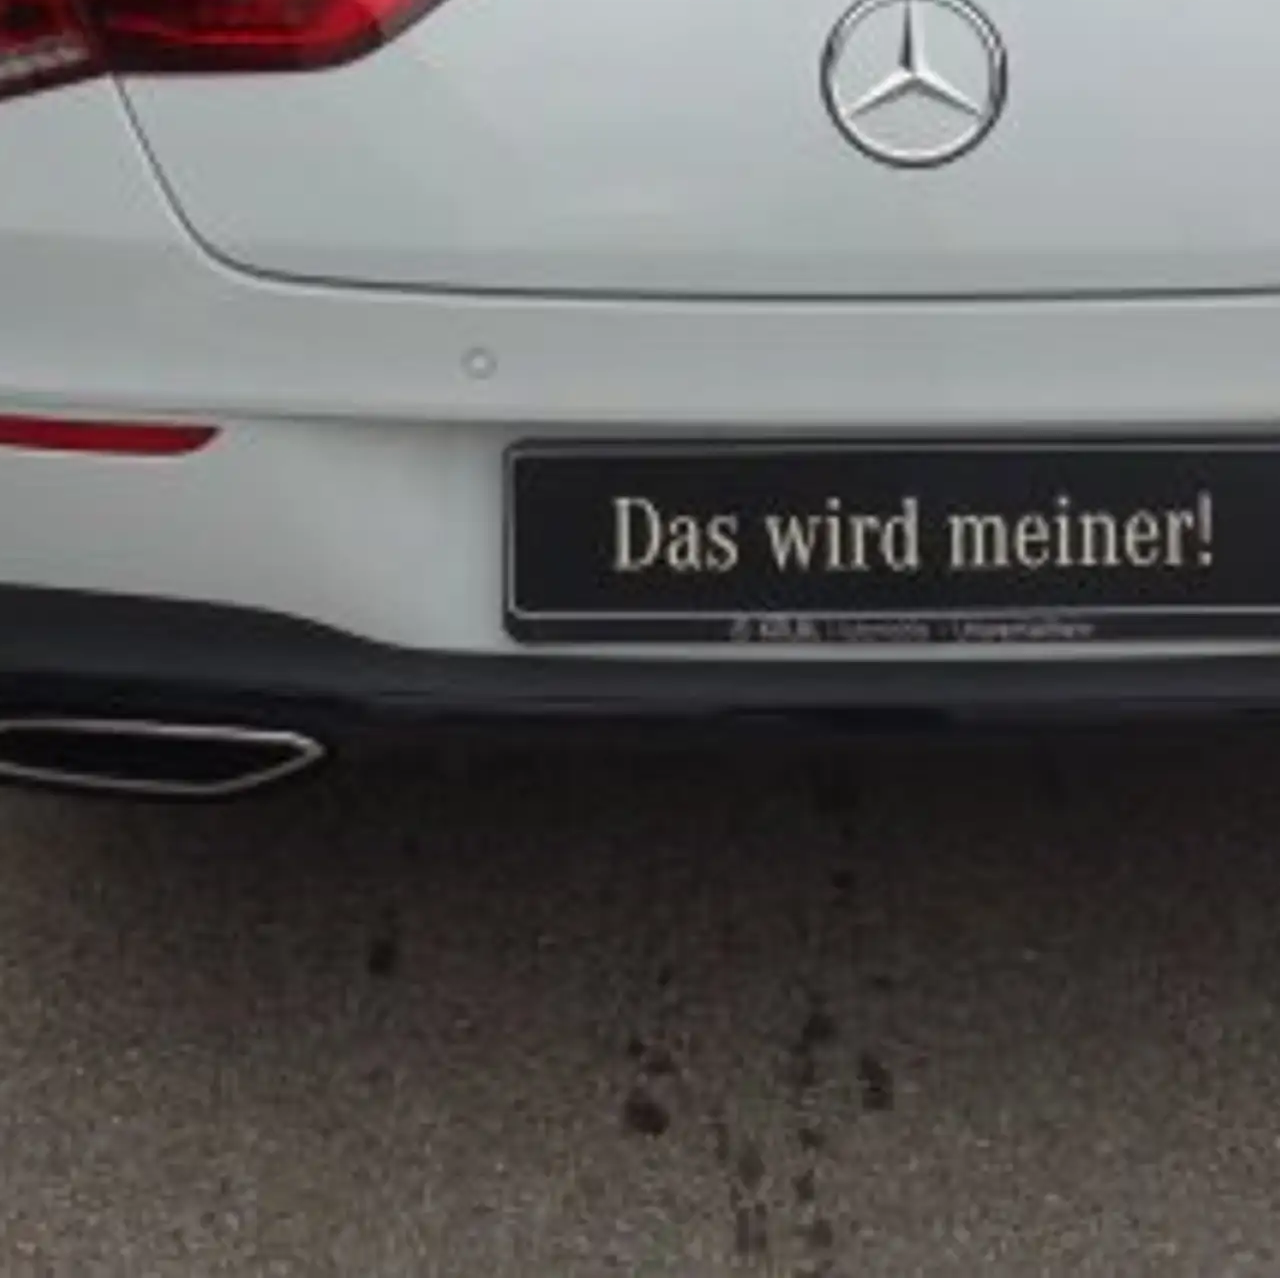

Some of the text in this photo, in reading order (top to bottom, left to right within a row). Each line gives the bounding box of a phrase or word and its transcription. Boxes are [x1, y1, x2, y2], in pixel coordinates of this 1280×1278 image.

[612, 493, 1214, 572] Das wird meiner!
